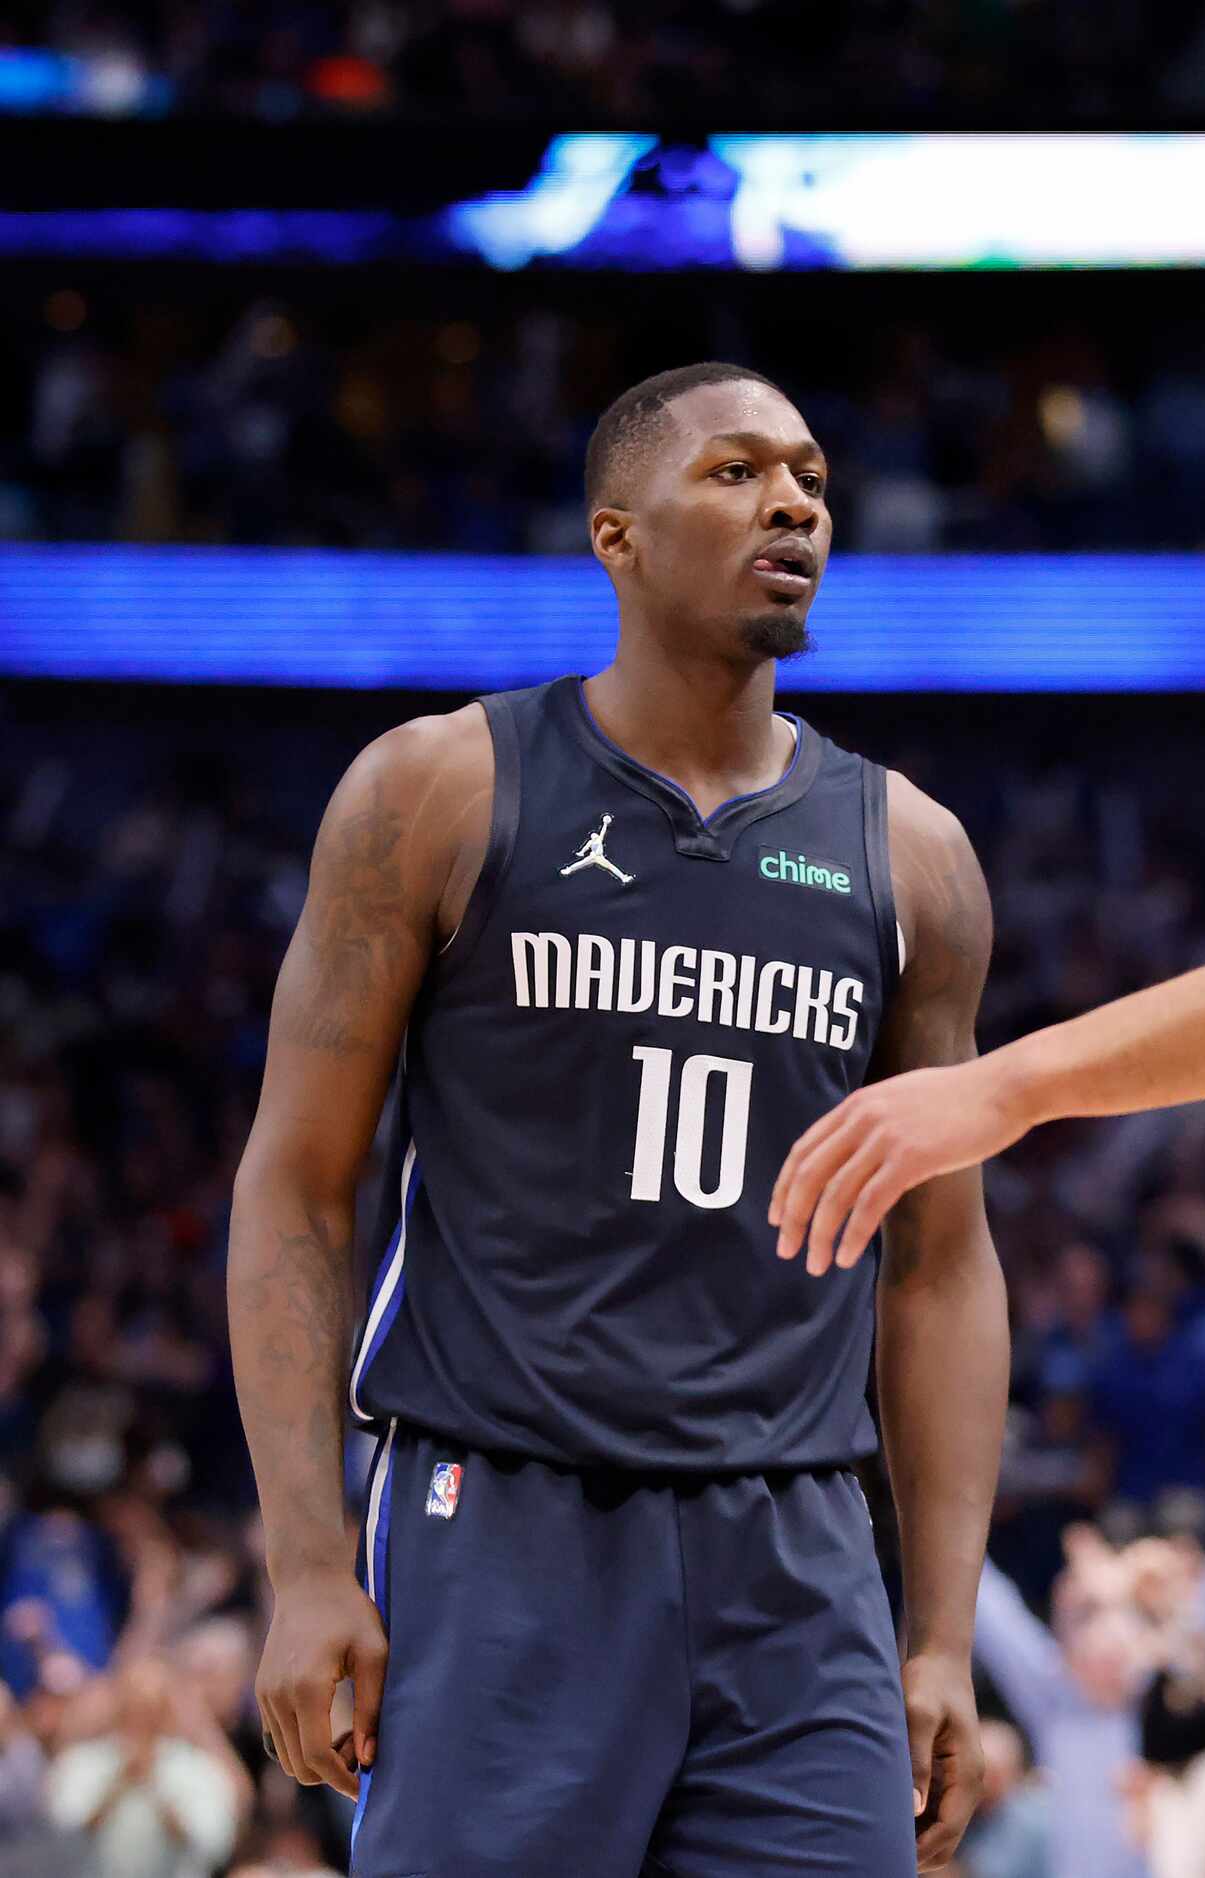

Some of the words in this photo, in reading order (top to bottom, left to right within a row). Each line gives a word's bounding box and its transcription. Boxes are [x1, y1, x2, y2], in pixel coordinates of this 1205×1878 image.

[760, 851, 851, 893] chime
[511, 932, 864, 1051] MAVERICKS
[630, 1045, 753, 1209] 10
